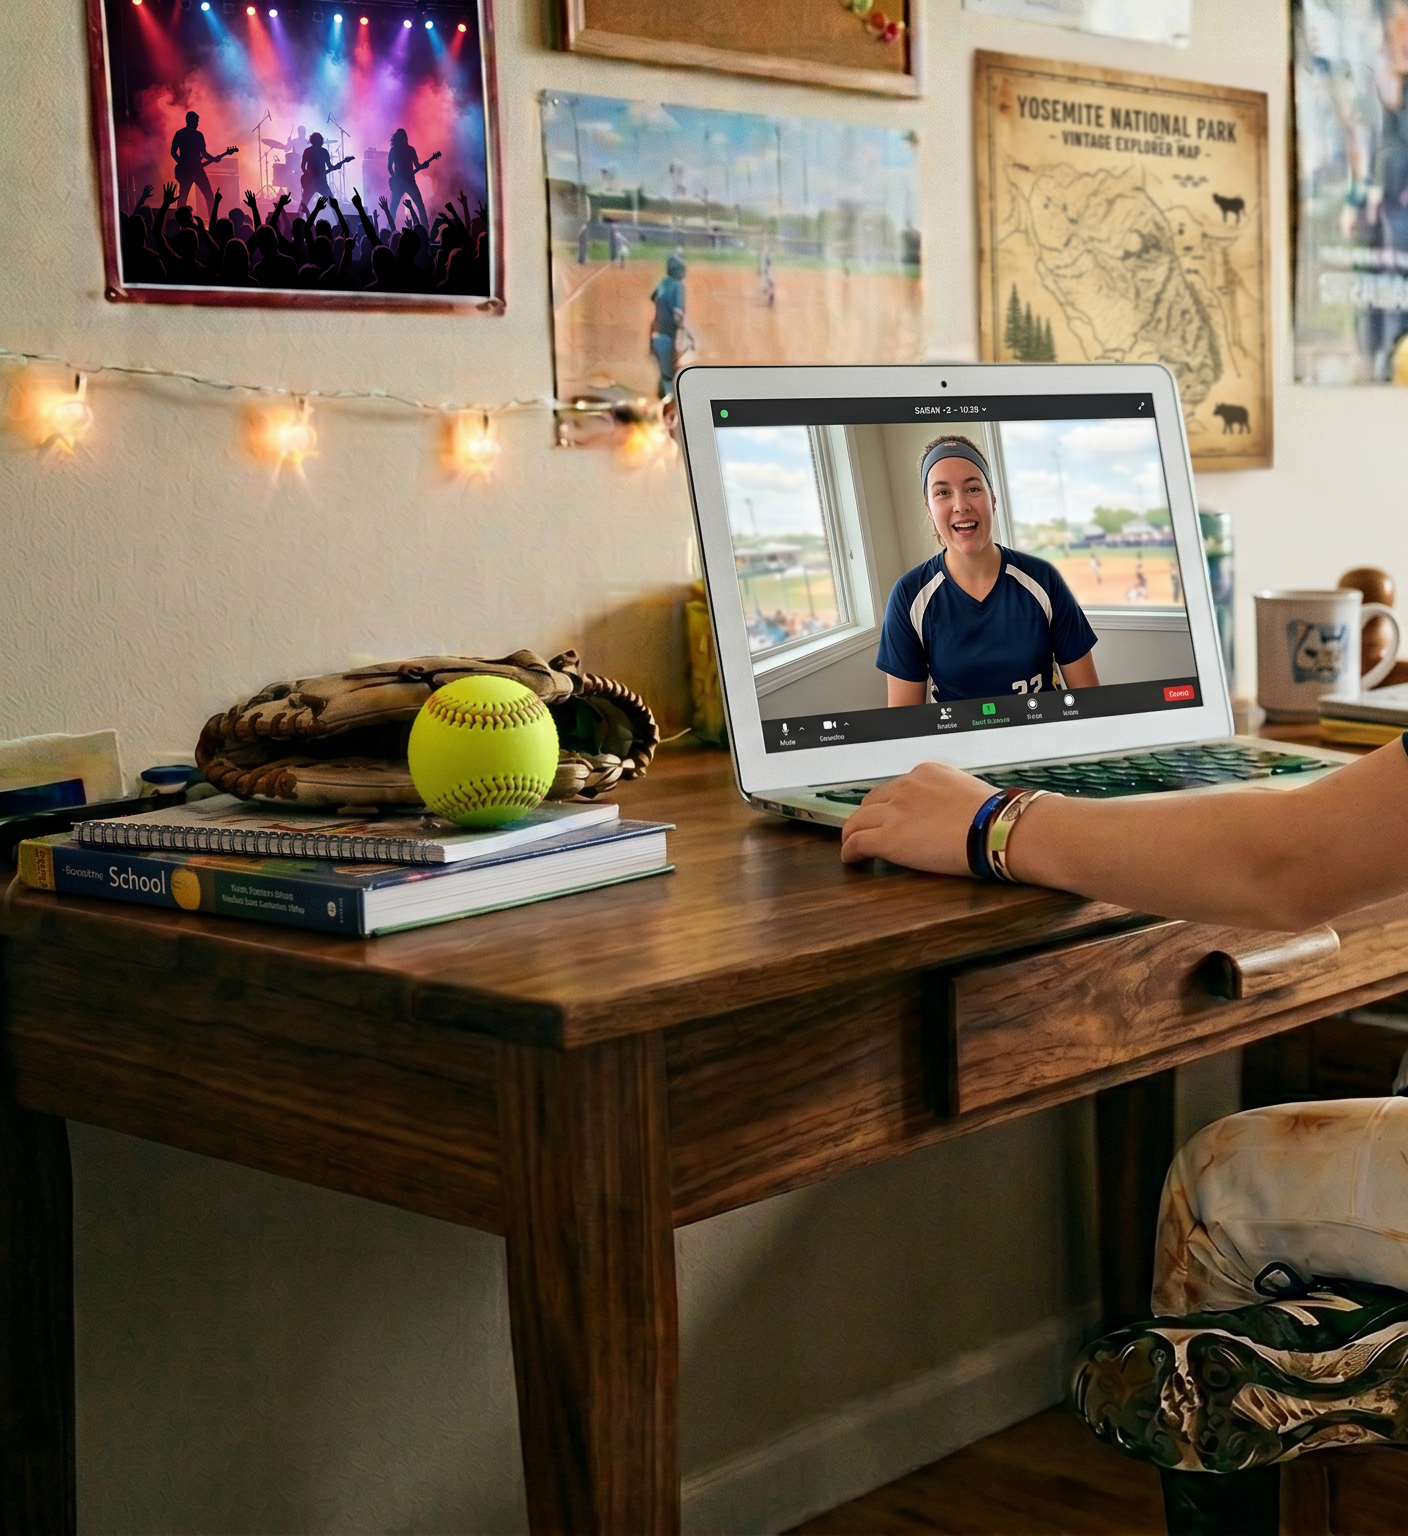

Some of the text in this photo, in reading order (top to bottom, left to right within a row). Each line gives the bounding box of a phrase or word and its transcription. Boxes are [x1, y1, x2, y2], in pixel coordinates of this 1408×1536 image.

[1016, 94, 1237, 143] YOSEMITE NATIONAL PARK
[1062, 130, 1112, 151] VINTAGE
[1115, 135, 1173, 157] EXPLORER
[1176, 142, 1201, 160] MAP
[108, 866, 166, 895] School
